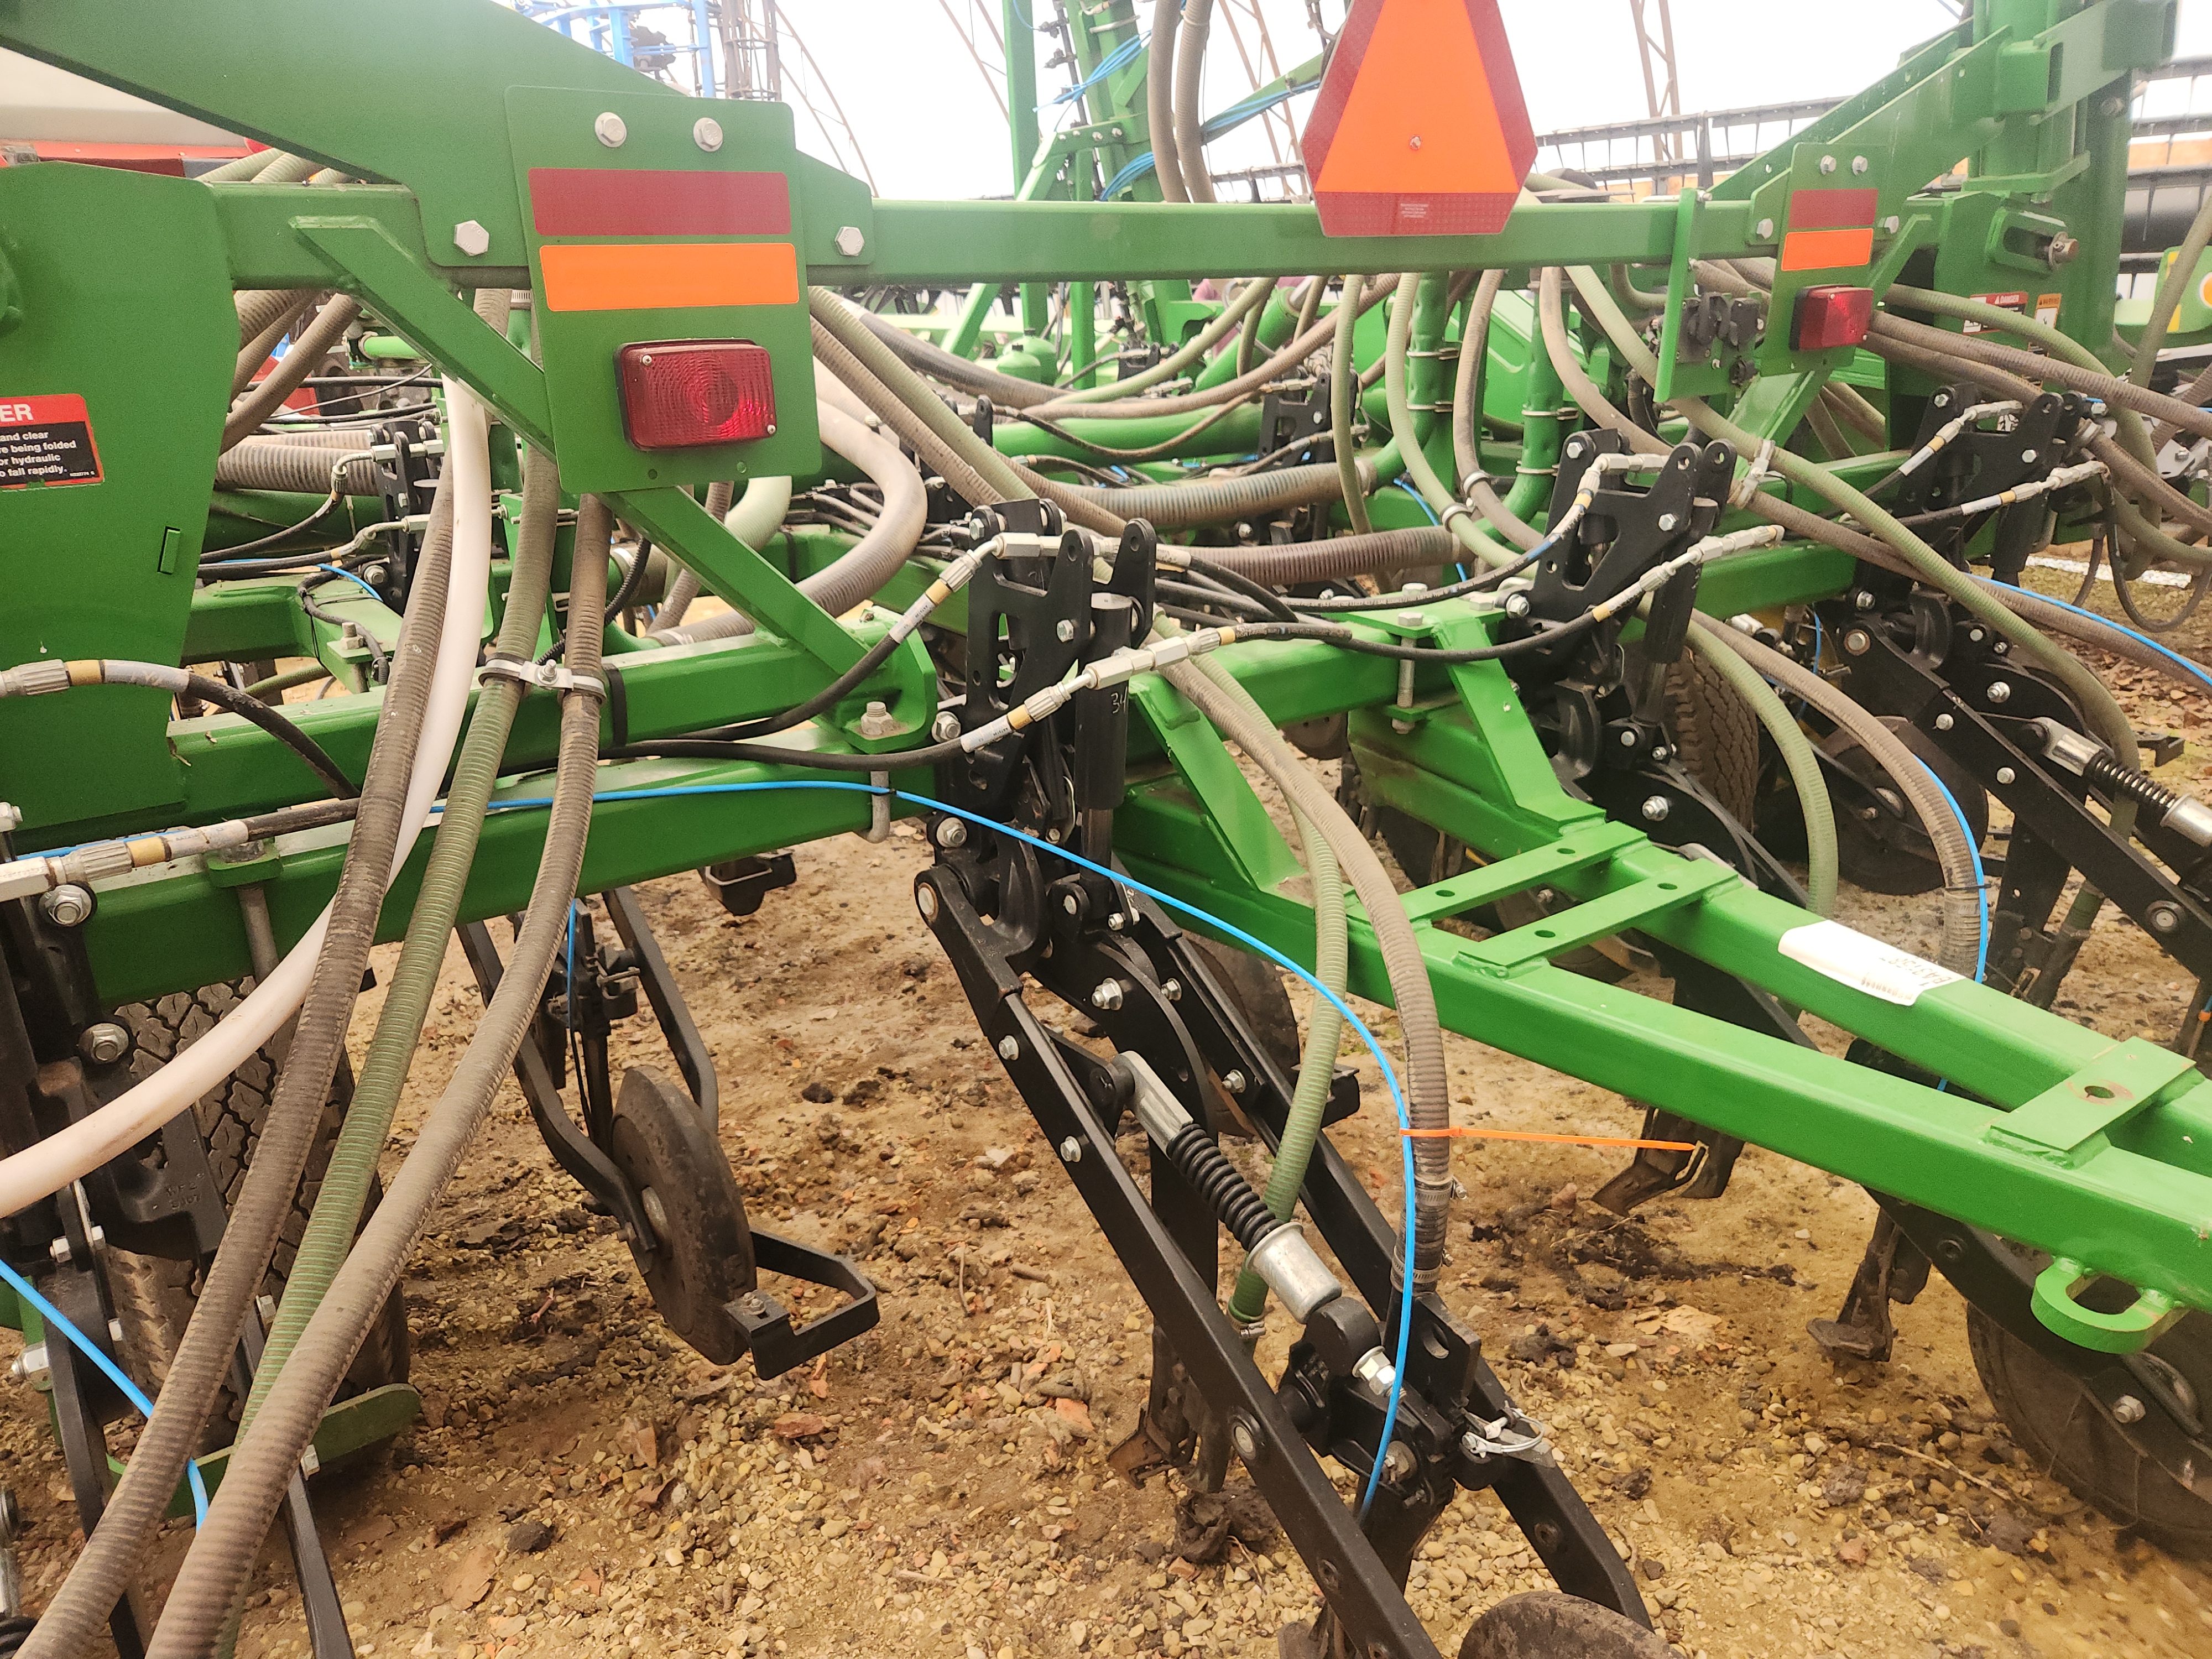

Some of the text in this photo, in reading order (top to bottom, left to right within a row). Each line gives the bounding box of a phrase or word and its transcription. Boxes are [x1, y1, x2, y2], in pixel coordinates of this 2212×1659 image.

[0, 431, 49, 442] and clear
[11, 444, 41, 453] being
[43, 440, 77, 450] folded
[11, 453, 61, 466] hydraulic
[8, 467, 25, 477] fall
[28, 465, 67, 476] rapidly.
